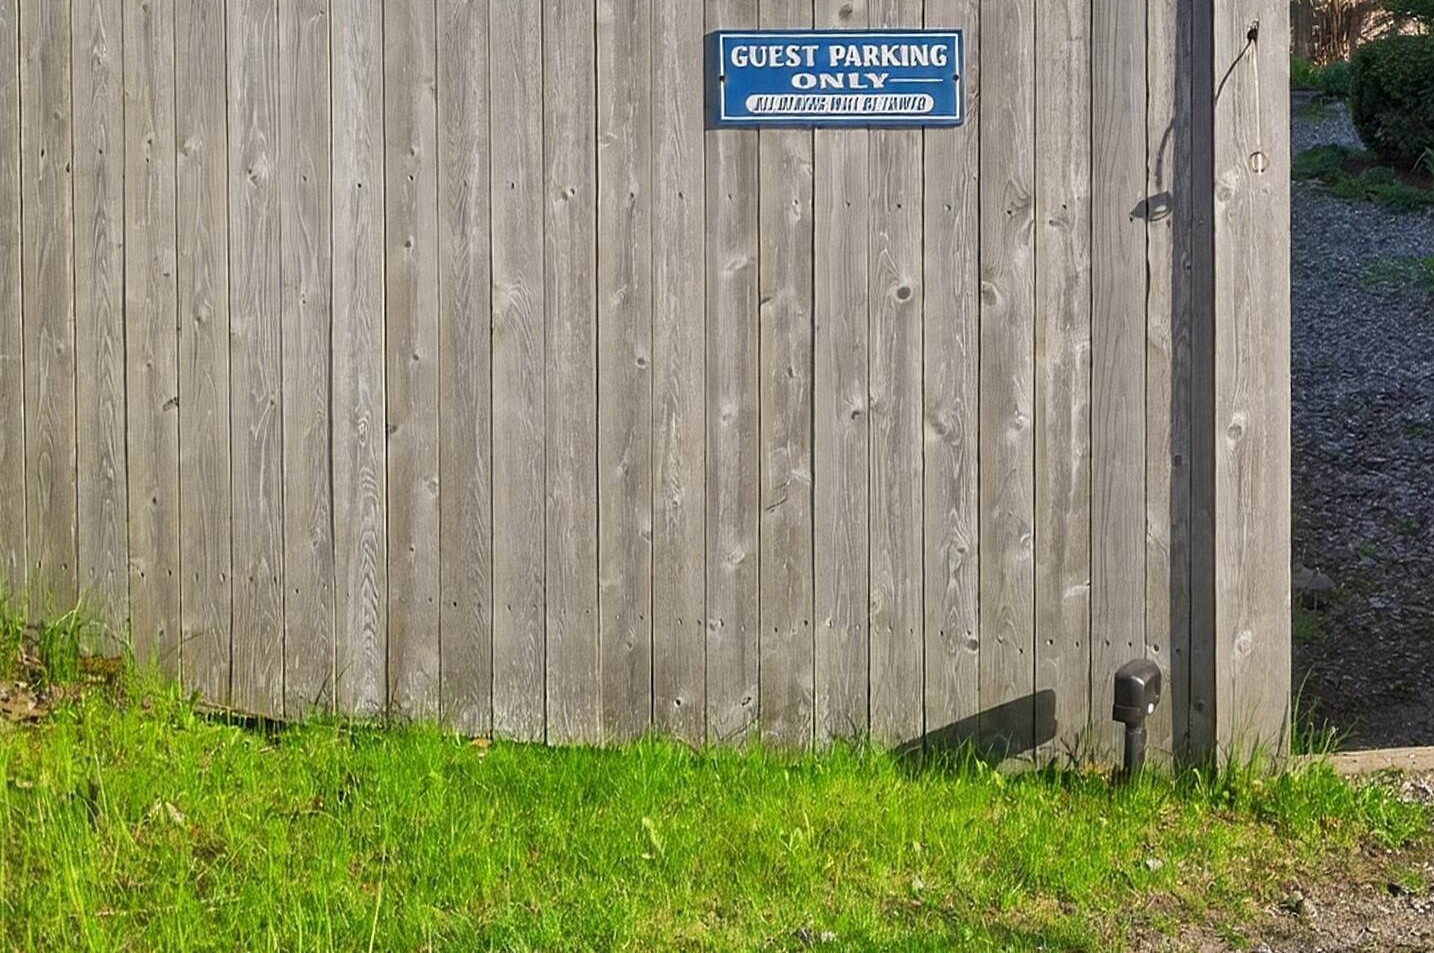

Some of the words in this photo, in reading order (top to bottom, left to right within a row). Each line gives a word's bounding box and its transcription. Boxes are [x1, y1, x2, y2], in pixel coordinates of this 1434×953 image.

[731, 45, 818, 67] GUEST
[829, 45, 947, 67] PARKING
[791, 73, 889, 89] ONLY
